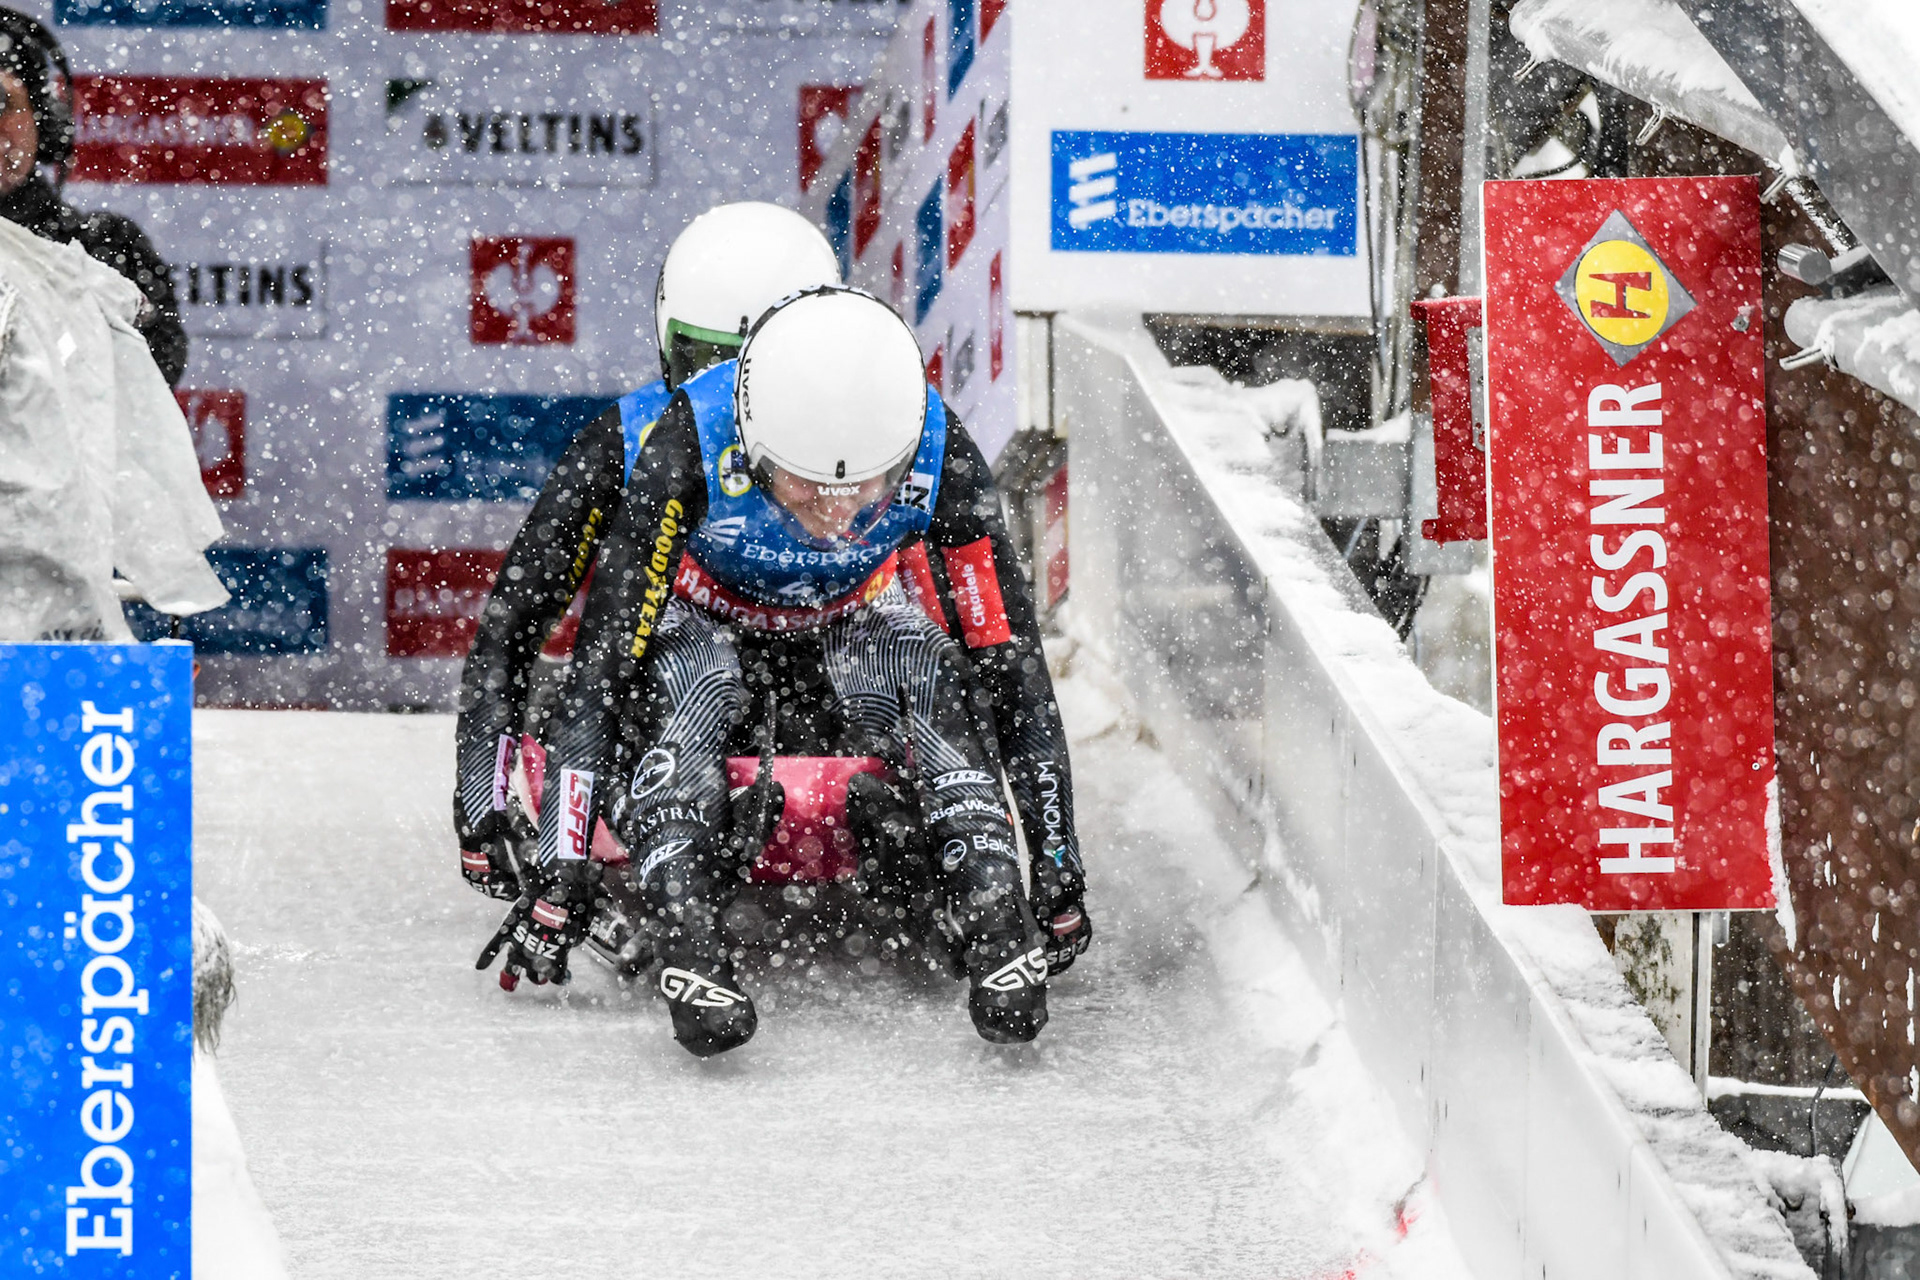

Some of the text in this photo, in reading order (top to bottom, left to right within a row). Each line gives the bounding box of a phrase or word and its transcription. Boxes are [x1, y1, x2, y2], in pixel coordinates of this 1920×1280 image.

[458, 112, 643, 155] VELTINS
[172, 264, 313, 305] LTINS
[741, 357, 753, 422] uvex
[816, 484, 861, 497] uvex
[631, 499, 684, 659] GOODYEAR
[680, 568, 858, 632] HARGASSNER
[903, 568, 922, 607] adele
[962, 563, 985, 627] Citadele
[1587, 382, 1675, 874] HARGASSNER
[567, 772, 592, 857] LSFP
[929, 797, 1008, 824] RigaWood
[973, 835, 1019, 861] Balc
[64, 700, 149, 1257] Eberspächer
[661, 966, 747, 1007] GTS
[982, 946, 1048, 991] GTS
